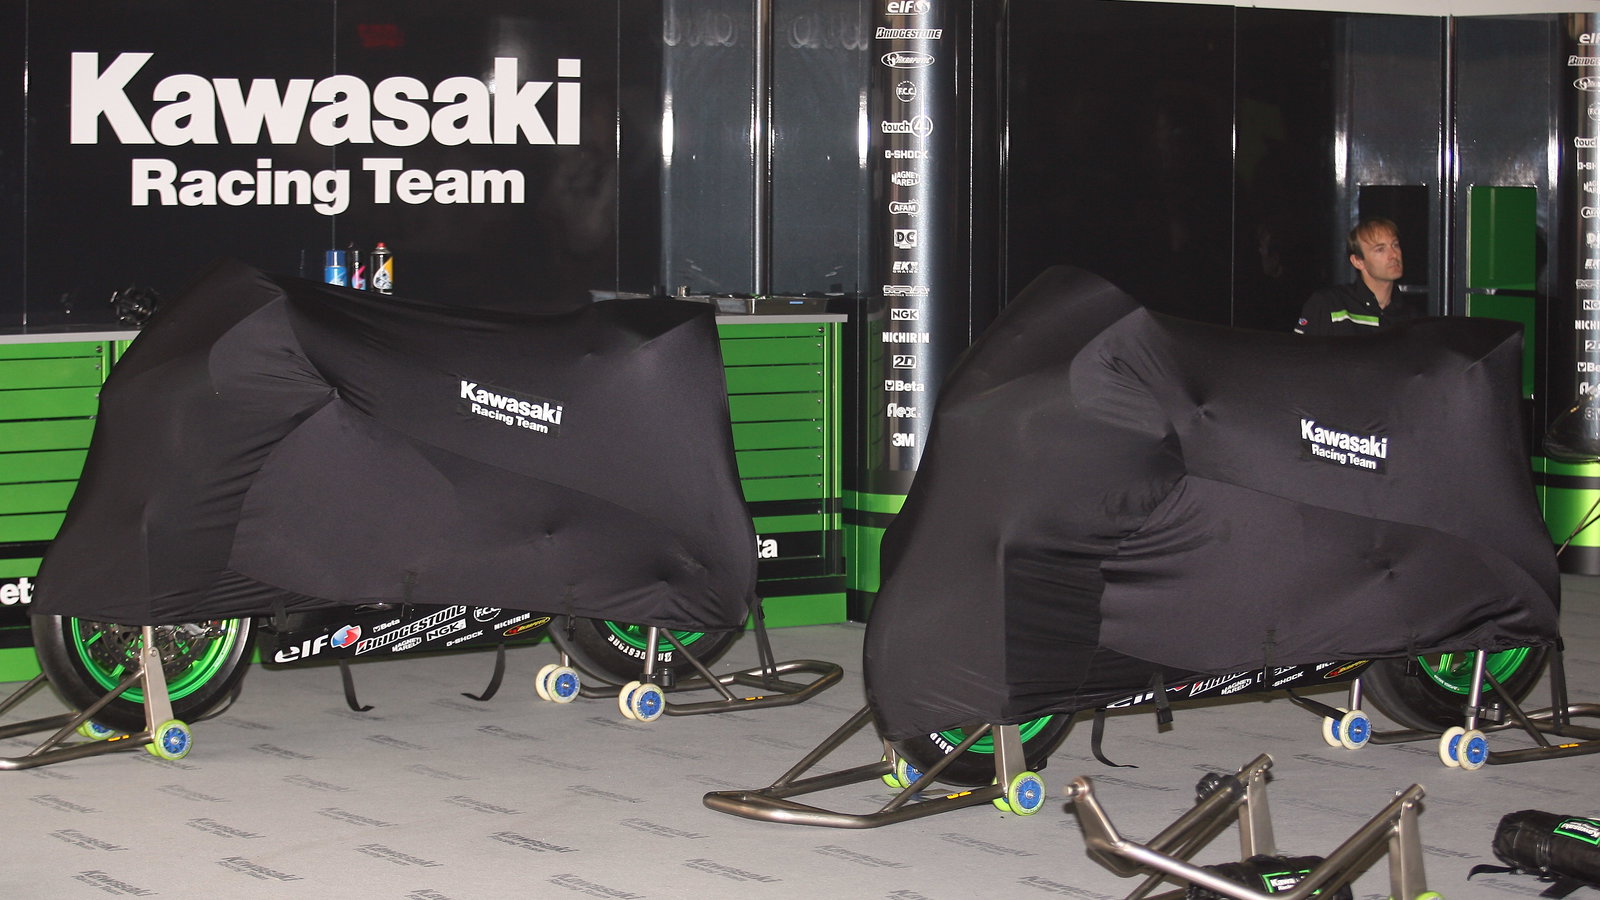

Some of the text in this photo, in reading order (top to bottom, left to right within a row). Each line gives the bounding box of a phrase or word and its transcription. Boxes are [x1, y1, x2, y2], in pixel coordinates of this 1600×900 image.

[887, 1, 915, 13] elf
[875, 27, 943, 39] BRIDGESTONE
[70, 52, 581, 146] Kawasaki
[882, 121, 911, 132] touch
[885, 150, 928, 159] G-SHOCK
[131, 158, 525, 216] Racing Team
[893, 204, 916, 212] AFAM
[892, 310, 918, 319] NGK
[882, 332, 930, 344] NICHIRIN
[895, 380, 925, 392] Beta
[460, 380, 562, 425] Kawasaki
[471, 403, 549, 434] Racing Team
[892, 433, 915, 447] 3M
[1300, 418, 1388, 459] Kawasaki
[1311, 443, 1377, 470] Racing Team
[355, 605, 467, 656] BRIDGESTONE
[428, 620, 460, 641] NGK
[494, 613, 531, 631] NICHIRIN
[446, 630, 484, 647] G-SHOCK
[274, 634, 330, 663] elf
